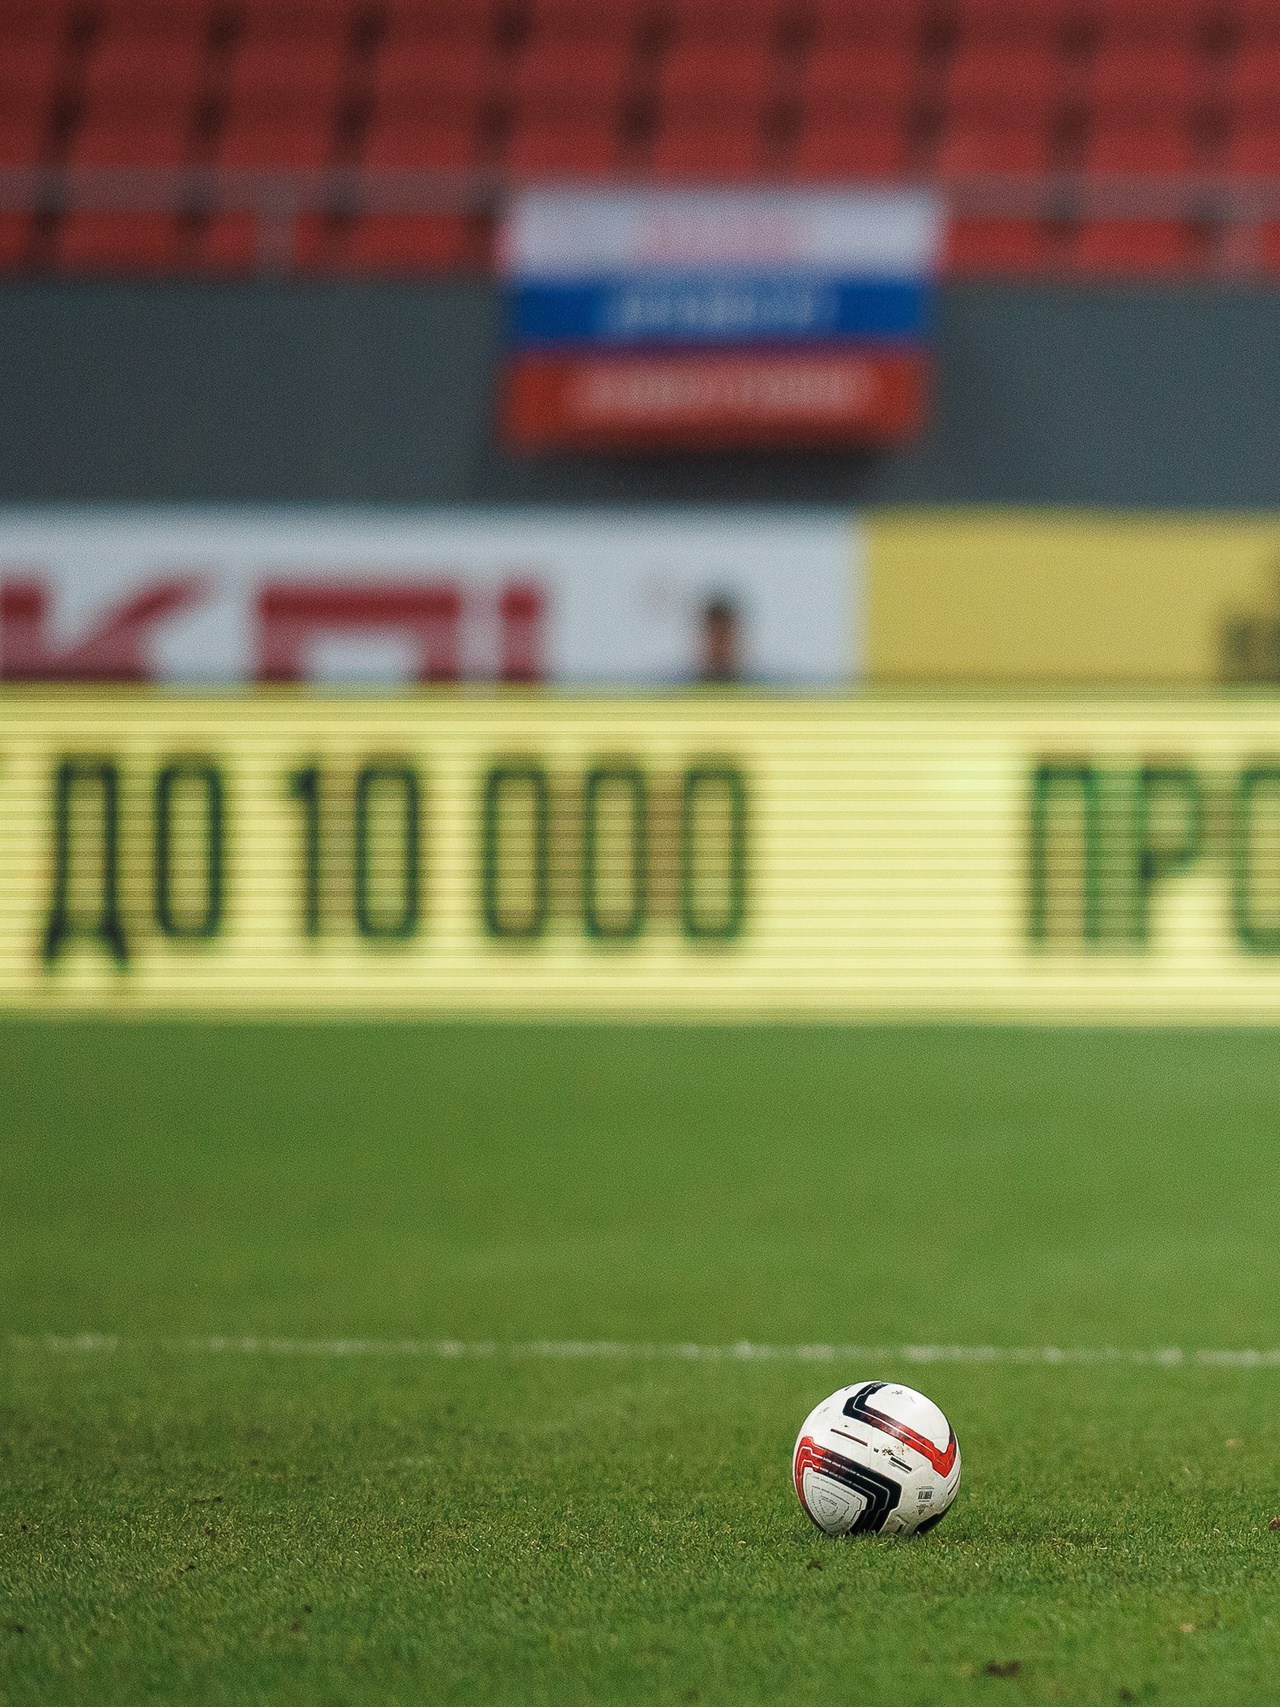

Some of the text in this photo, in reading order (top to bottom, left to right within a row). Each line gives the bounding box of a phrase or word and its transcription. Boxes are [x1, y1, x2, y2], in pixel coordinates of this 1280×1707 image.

[42, 752, 750, 972] ДО 10 000
